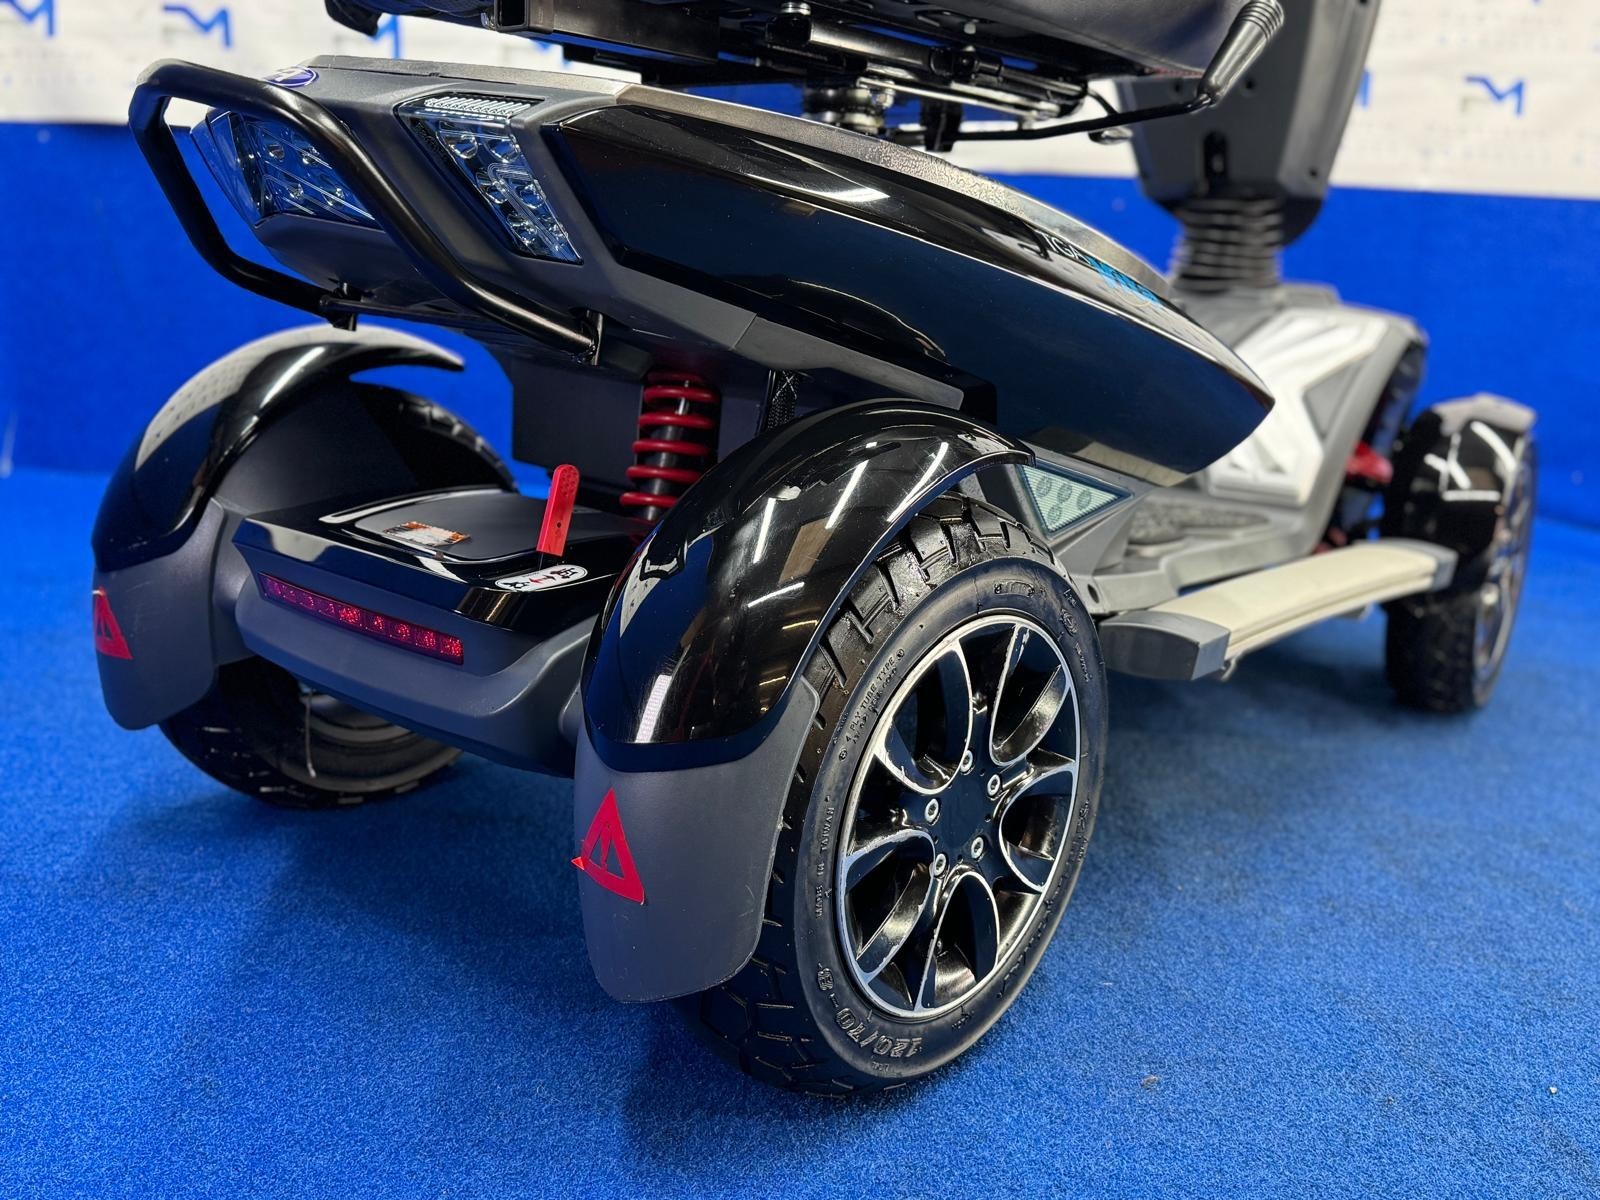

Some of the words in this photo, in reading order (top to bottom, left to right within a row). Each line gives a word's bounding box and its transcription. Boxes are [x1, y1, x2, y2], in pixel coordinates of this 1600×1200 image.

[849, 711, 863, 731] PLY
[860, 682, 876, 709] TUBE
[876, 657, 895, 681] TYPE
